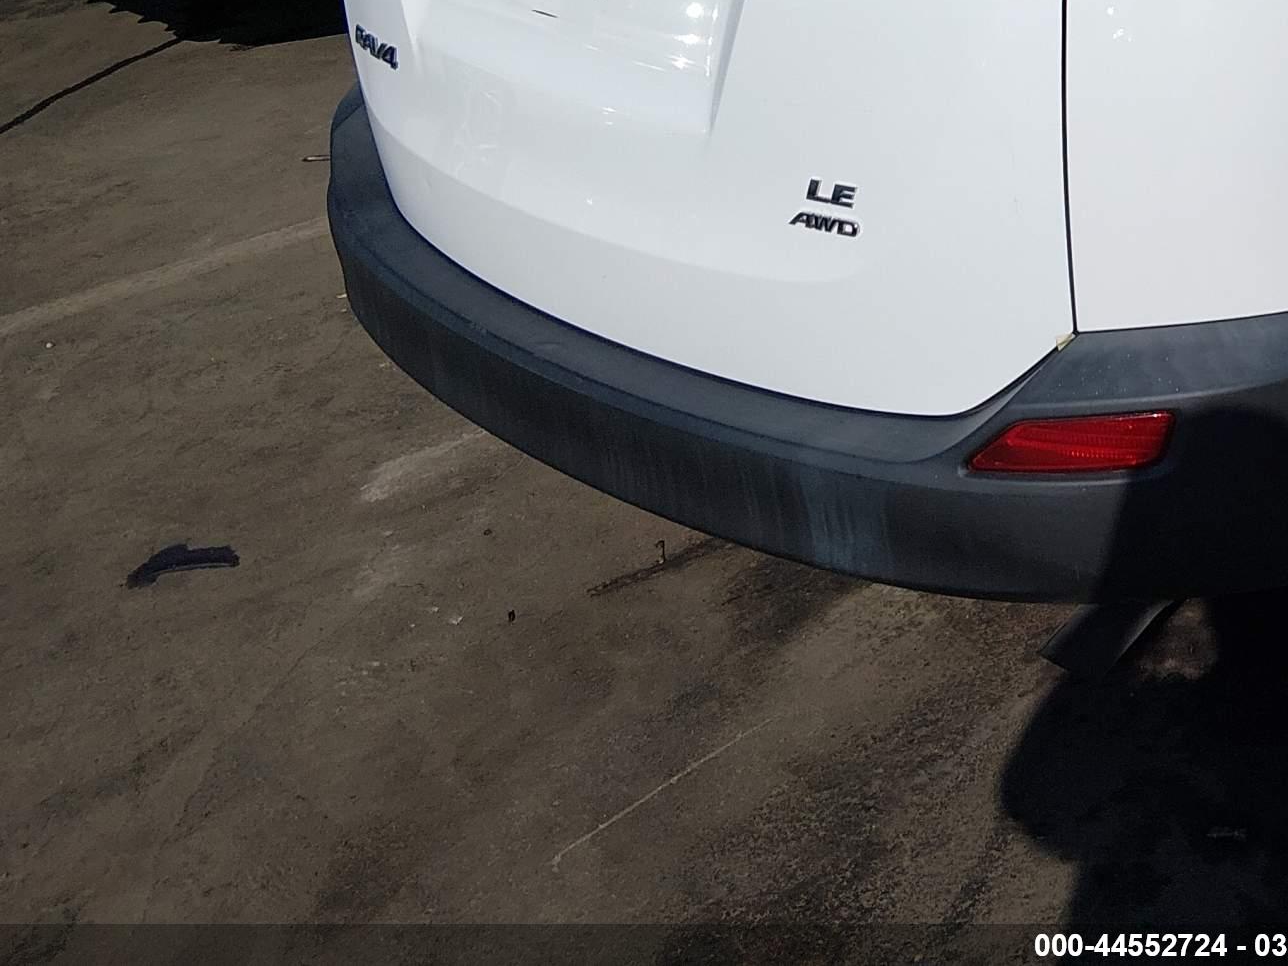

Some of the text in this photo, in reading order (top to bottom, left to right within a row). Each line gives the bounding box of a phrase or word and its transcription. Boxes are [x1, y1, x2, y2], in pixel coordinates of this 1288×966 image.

[355, 24, 399, 70] RAV4
[806, 178, 857, 209] LE
[788, 211, 861, 237] AWD
